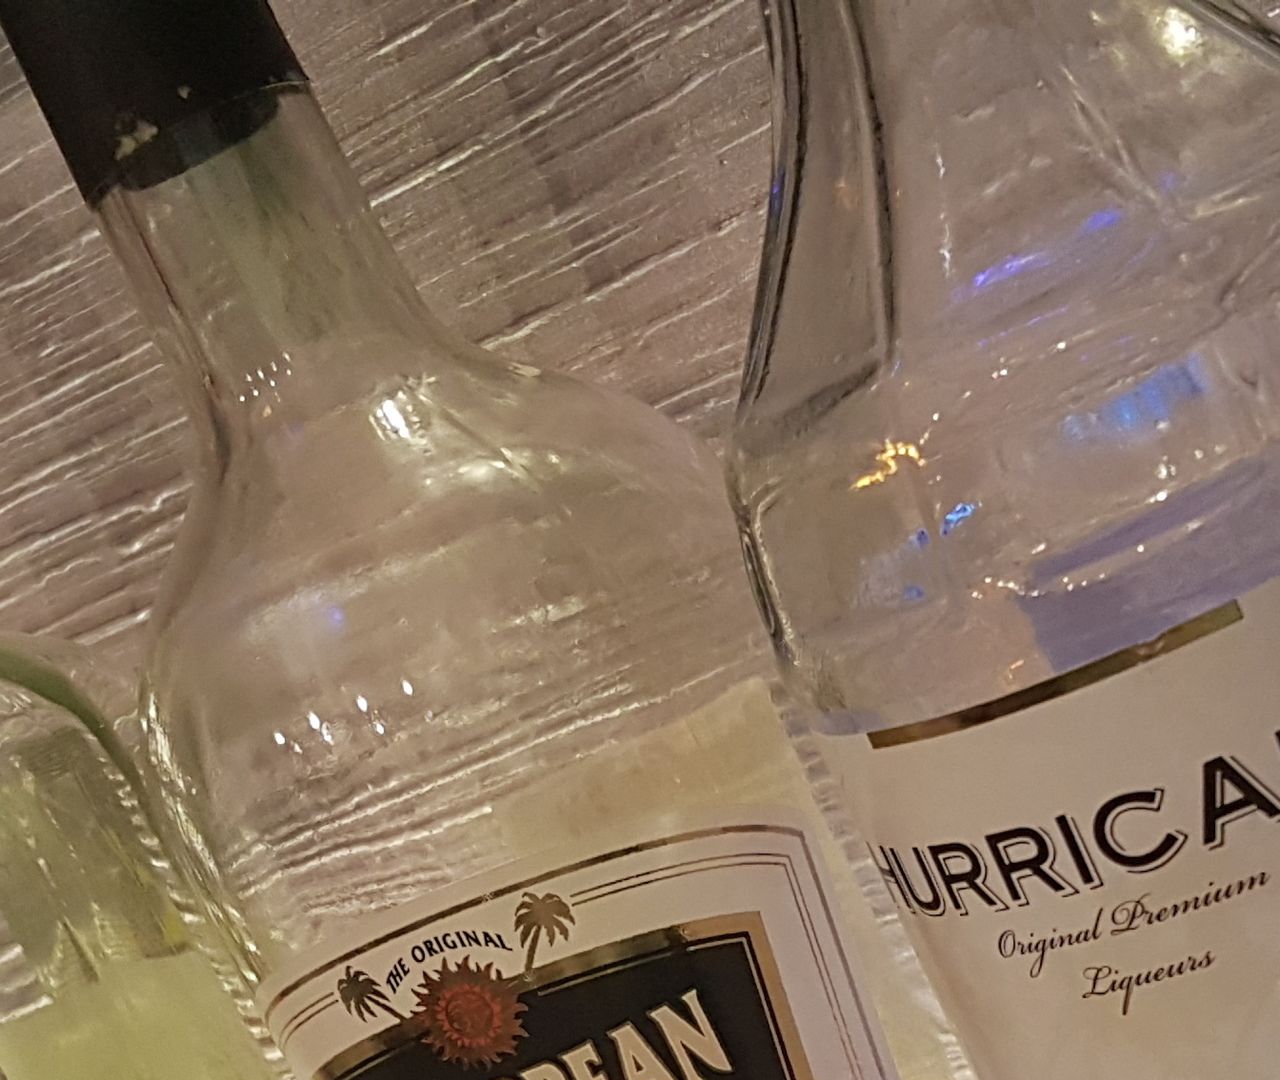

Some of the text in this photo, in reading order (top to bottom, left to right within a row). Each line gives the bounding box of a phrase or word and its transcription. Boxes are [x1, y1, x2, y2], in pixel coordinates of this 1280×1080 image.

[996, 868, 1271, 978] Original Premium
[385, 930, 514, 995] THE ORIGINAL
[1081, 948, 1217, 1016] Liqueurs
